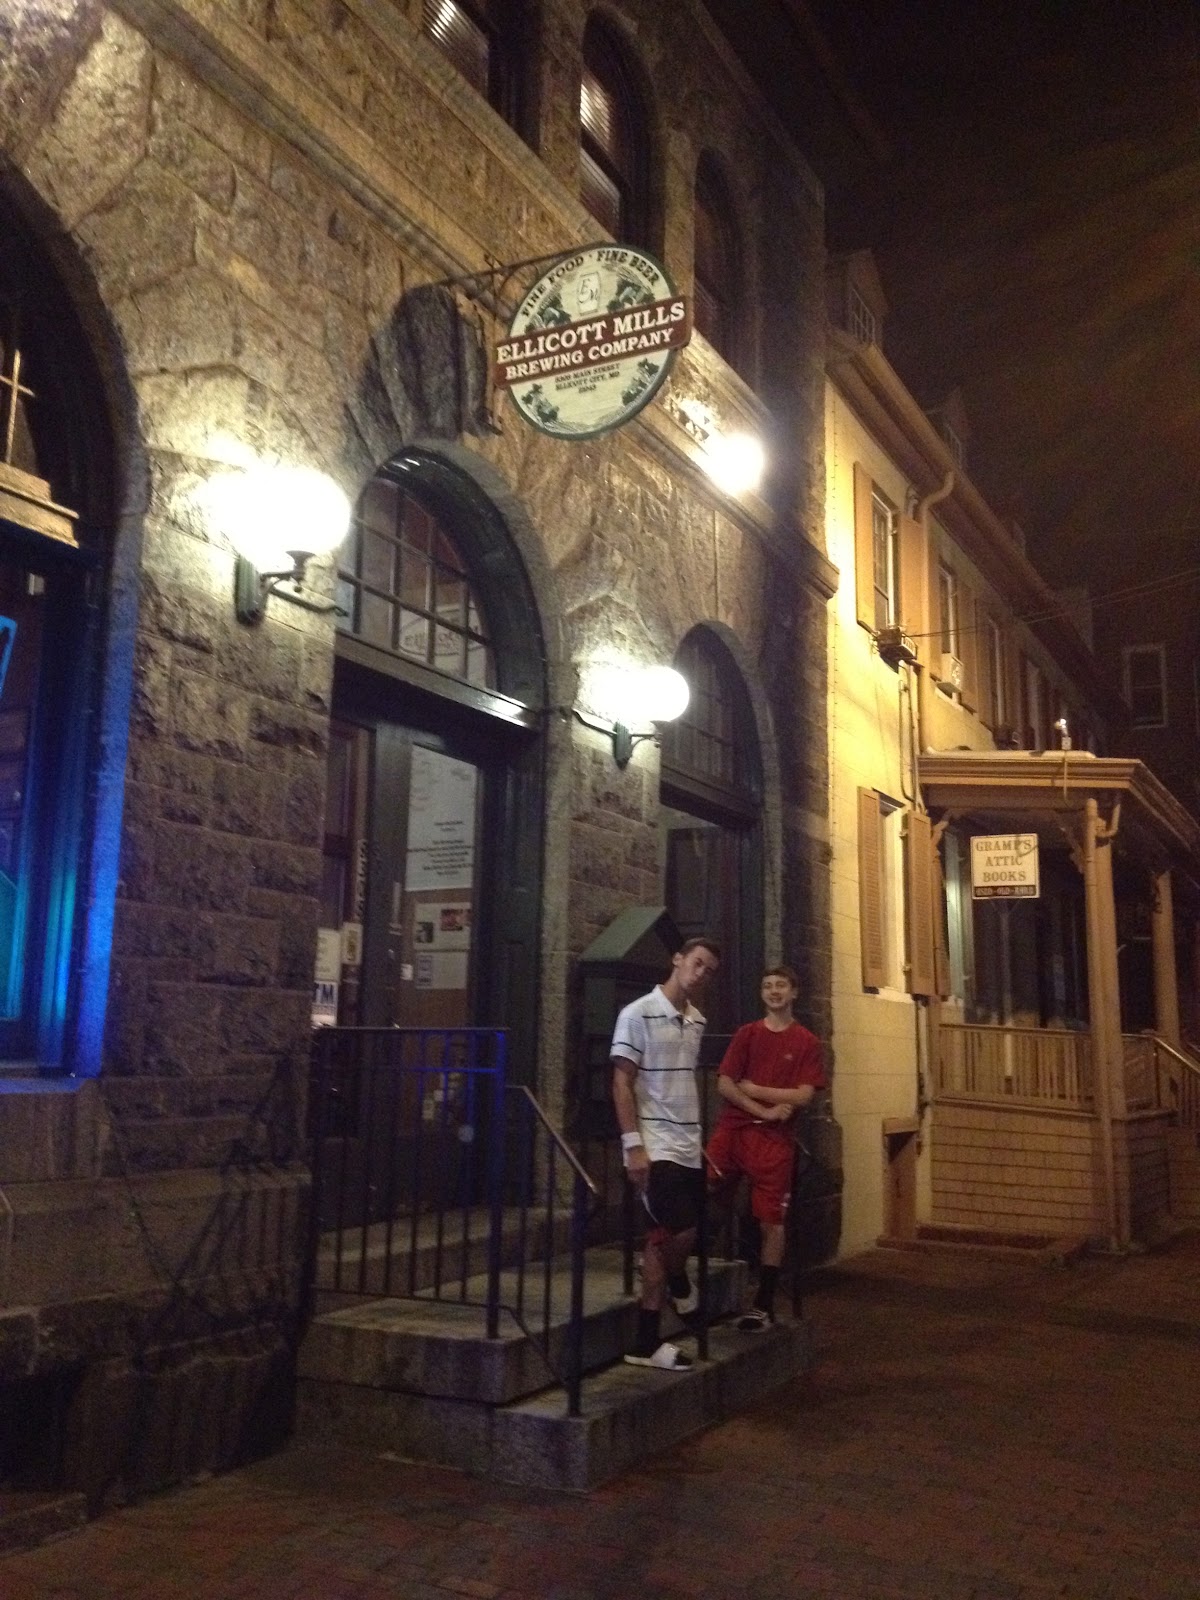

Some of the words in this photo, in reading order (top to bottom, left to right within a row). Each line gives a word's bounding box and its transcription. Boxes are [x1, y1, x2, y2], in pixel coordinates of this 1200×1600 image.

[522, 283, 545, 317] FINE
[549, 255, 585, 285] FOOD
[596, 249, 627, 264] FINE
[629, 253, 660, 286] BEER
[496, 319, 609, 364] ELLICOTT
[612, 301, 685, 337] MILLS
[505, 349, 584, 380] BREWING
[587, 327, 674, 361] COMPANY
[983, 871, 1026, 882] BOOKS
[986, 856, 1022, 866] ATTIC
